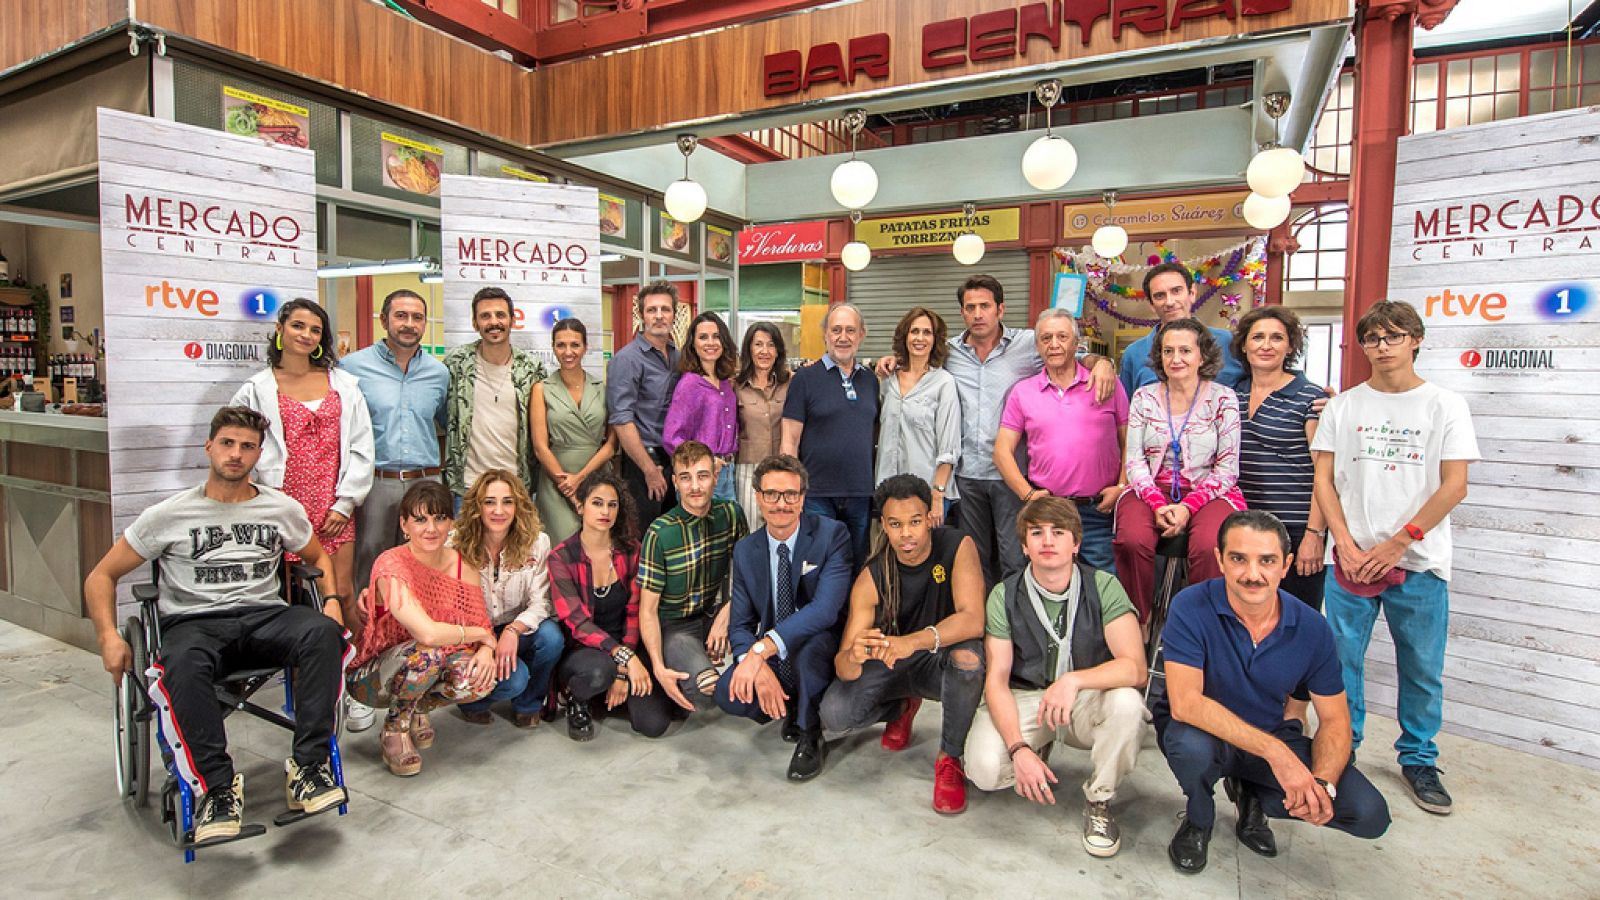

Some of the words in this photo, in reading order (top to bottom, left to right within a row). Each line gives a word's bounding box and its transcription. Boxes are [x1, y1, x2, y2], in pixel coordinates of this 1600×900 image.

[764, 33, 890, 97] BAR
[125, 193, 300, 243] MERCADO
[880, 219, 937, 234] PATATAS
[940, 215, 990, 229] FRITAS
[1093, 211, 1167, 226] Caramelos
[1171, 204, 1225, 222] Suárez
[1413, 194, 1600, 239] MERCAD
[126, 233, 301, 264] CENTRAL
[458, 236, 587, 266] MERCADO
[751, 230, 824, 257] Verduras
[892, 229, 976, 245] TORREZN
[458, 267, 588, 284] CENTRAL
[145, 280, 220, 317] rtve
[255, 293, 267, 315] 1
[1424, 288, 1508, 321] rtve
[1555, 288, 1572, 314] 1
[205, 343, 259, 361] DIAGONAL
[1485, 349, 1555, 369] DIAGONAL
